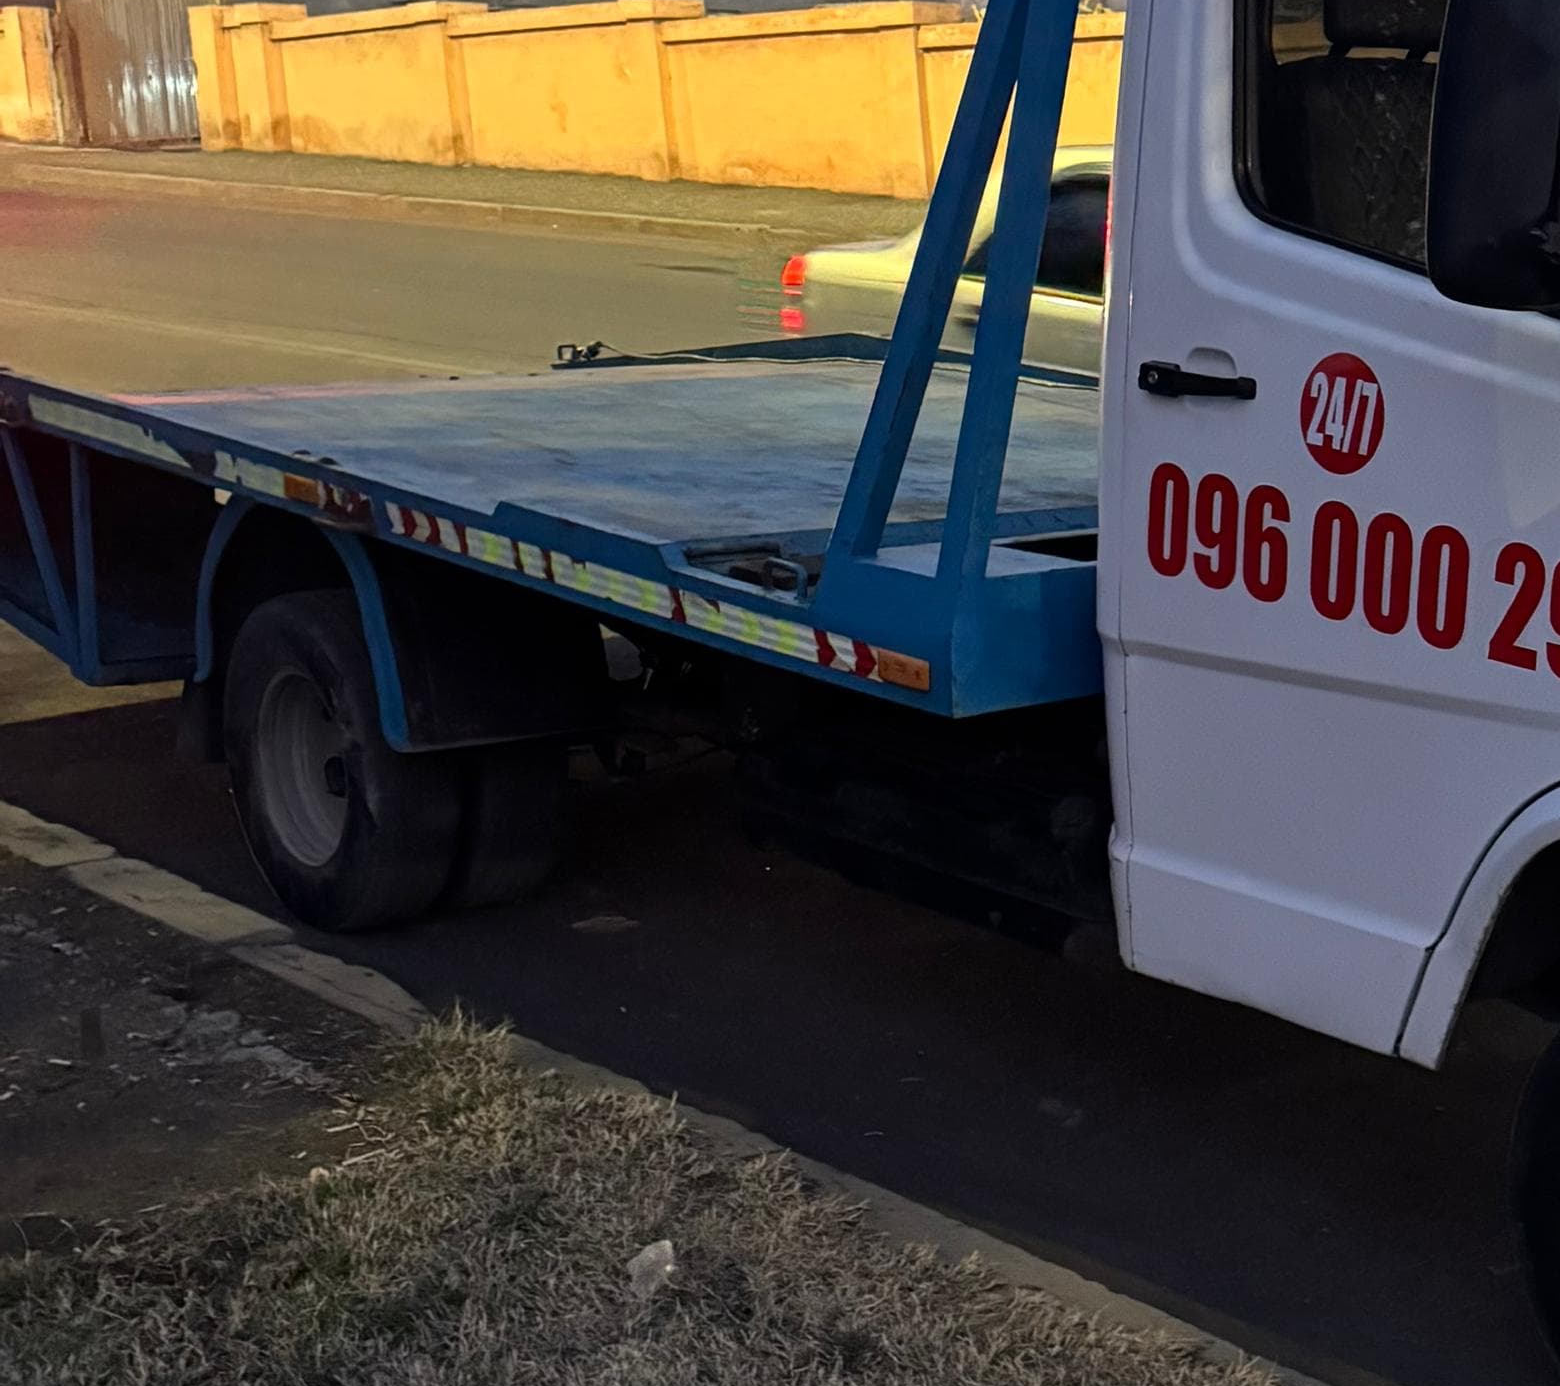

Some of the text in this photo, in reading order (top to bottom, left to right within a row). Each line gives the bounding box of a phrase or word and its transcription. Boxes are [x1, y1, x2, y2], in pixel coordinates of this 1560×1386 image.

[1307, 371, 1378, 455] 24/7
[1147, 462, 1291, 602] 096
[1310, 500, 1470, 650] 000
